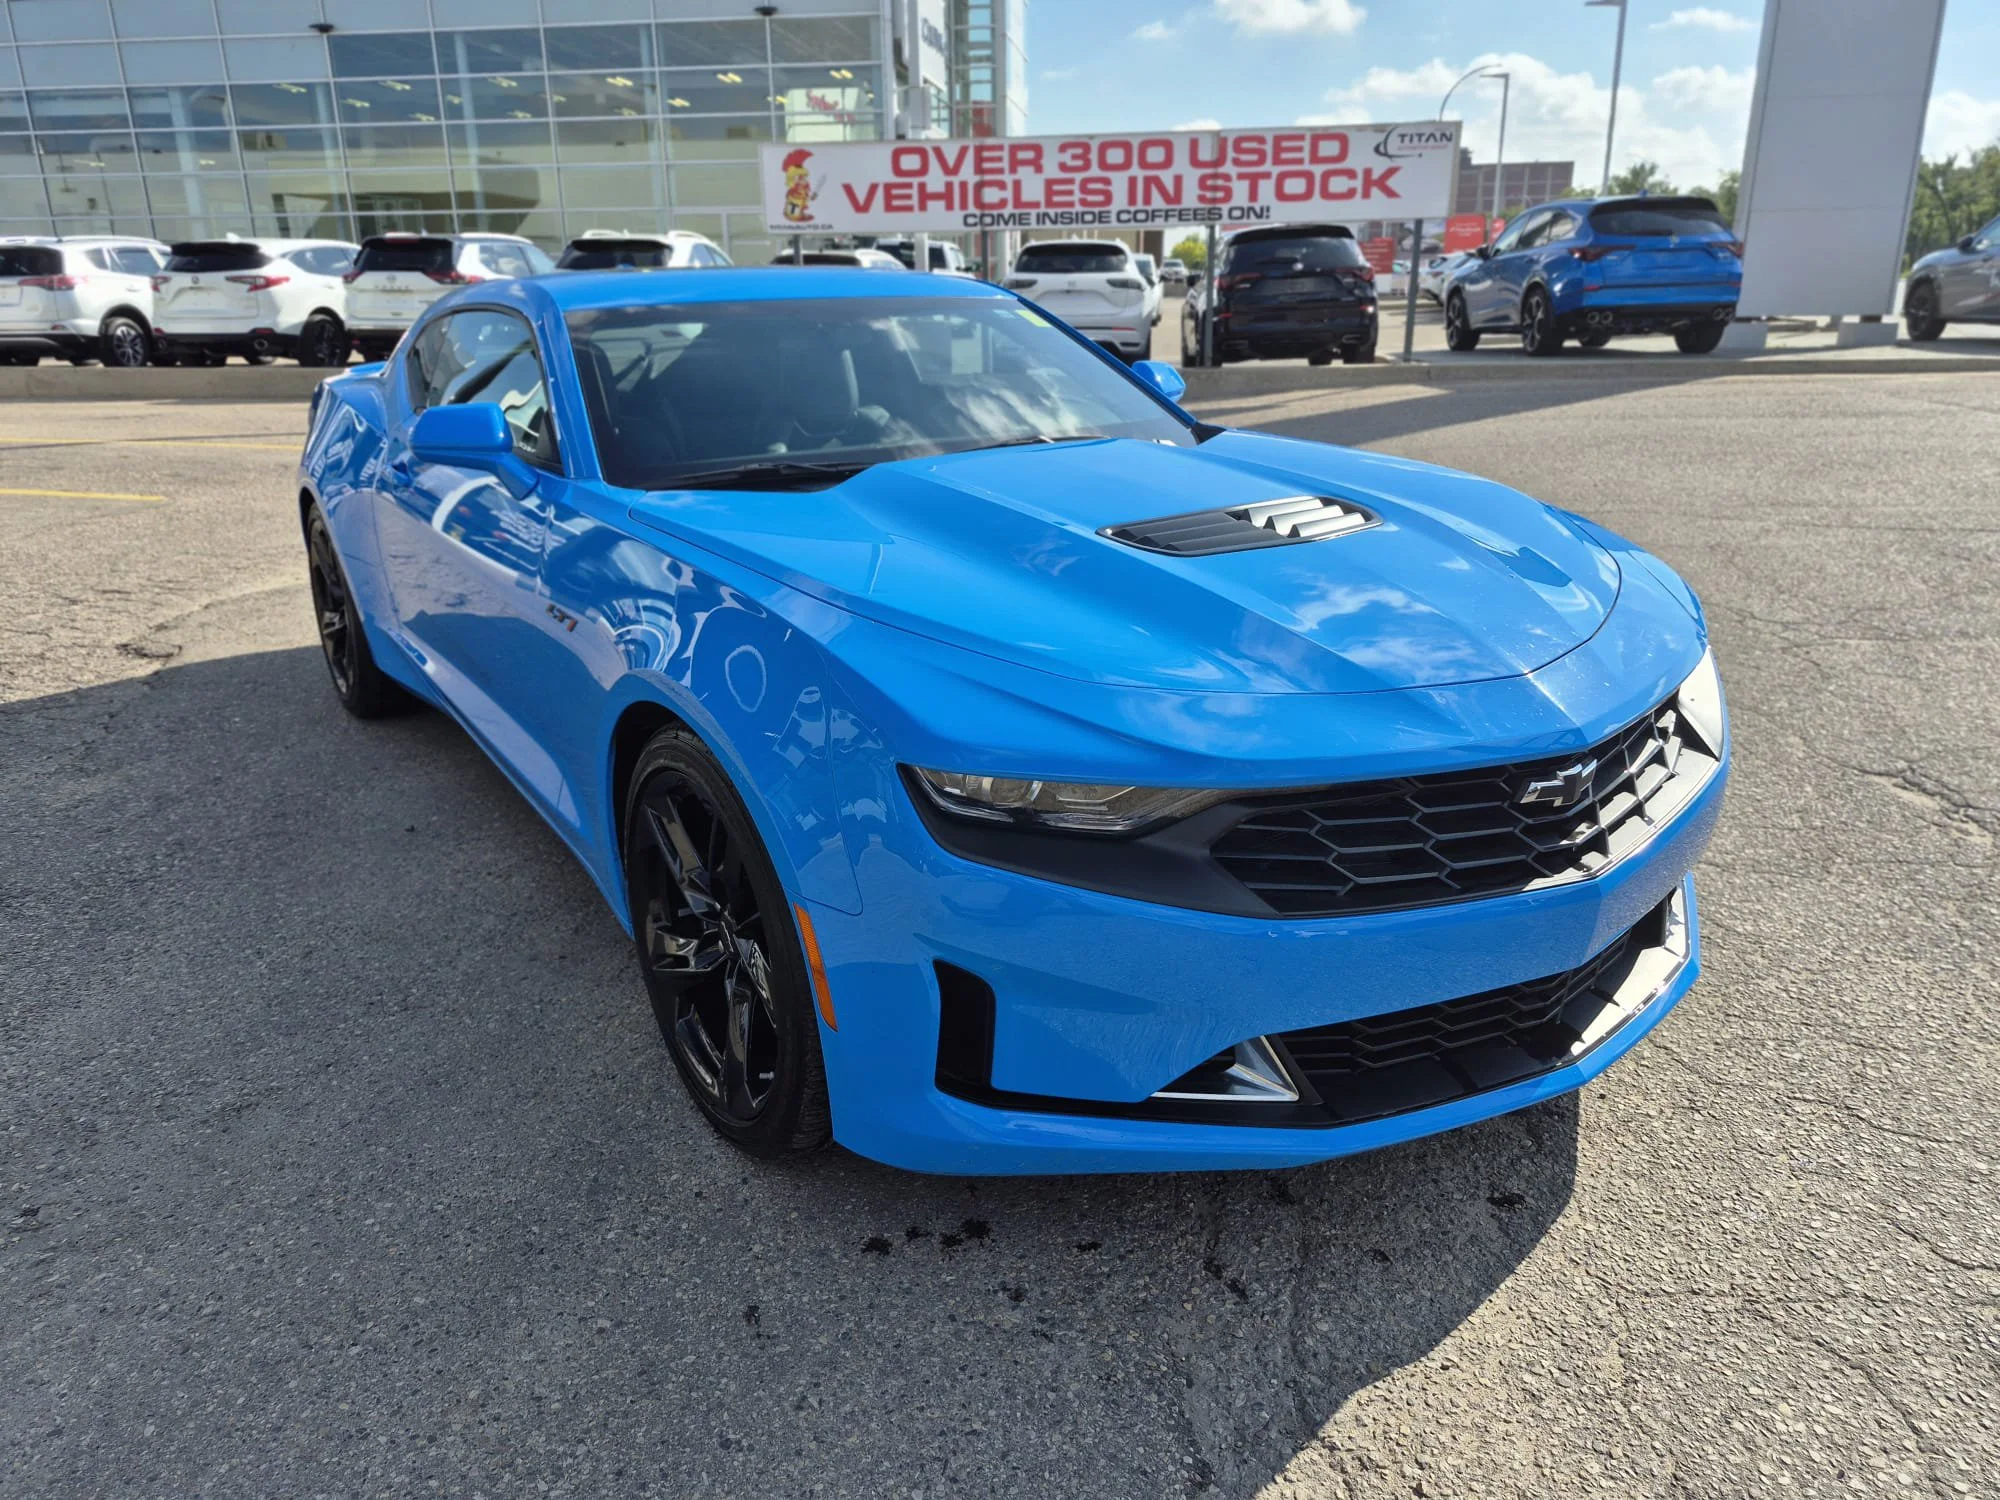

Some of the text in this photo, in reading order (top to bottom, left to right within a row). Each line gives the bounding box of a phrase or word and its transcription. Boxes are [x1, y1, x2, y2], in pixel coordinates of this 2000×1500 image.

[1397, 131, 1454, 144] TITAN
[891, 132, 1350, 178] OVER 300 USED
[841, 166, 1403, 214] VEHICLES IN STOCK
[963, 205, 1271, 228] COME INSIDE COFFEES ON!
